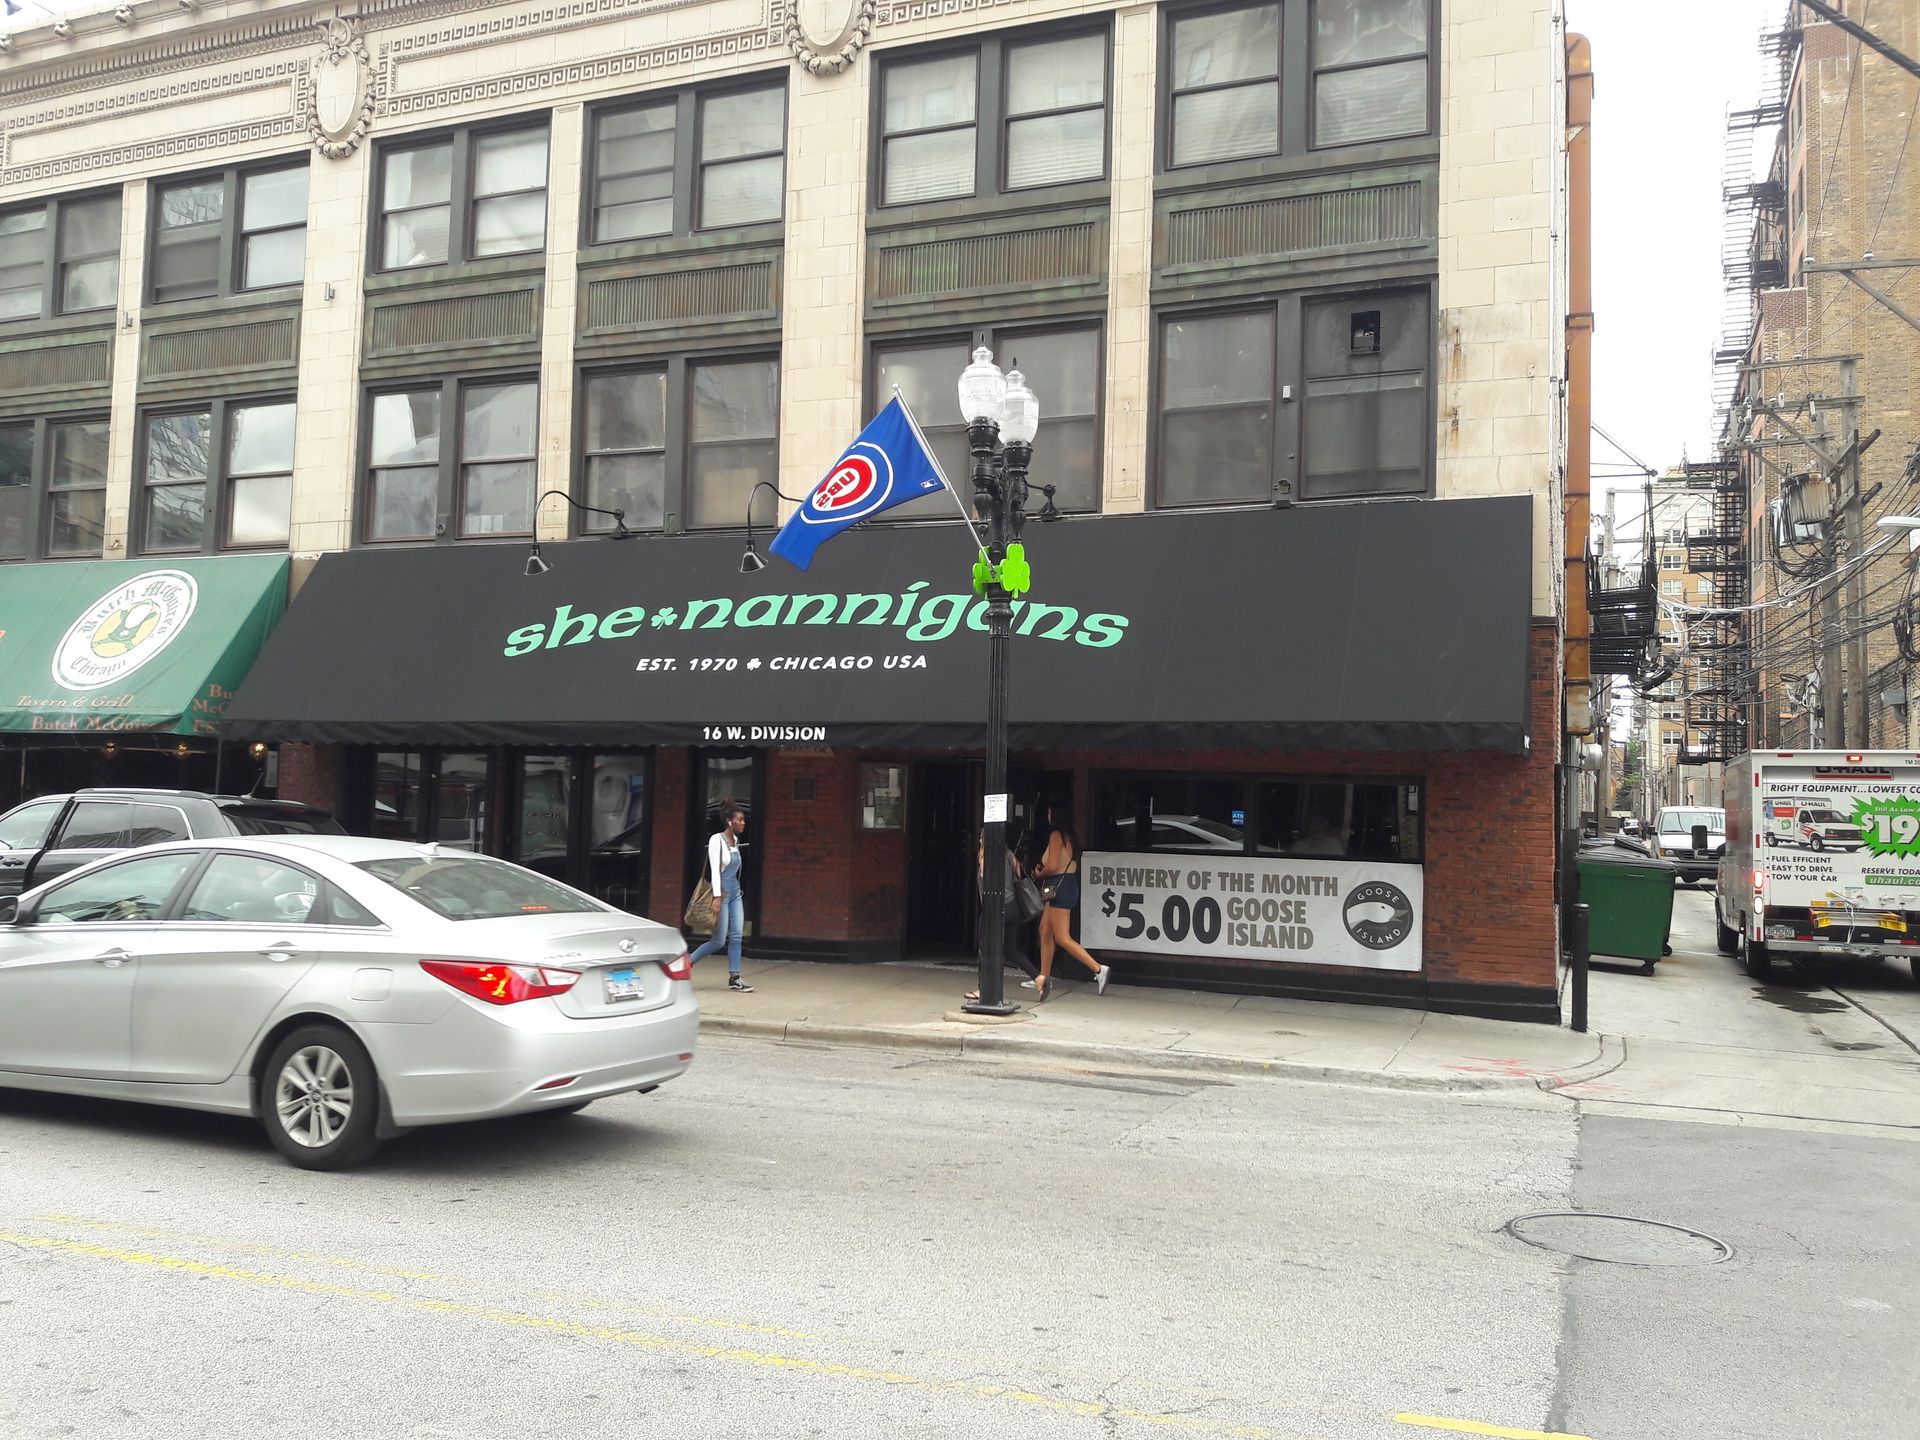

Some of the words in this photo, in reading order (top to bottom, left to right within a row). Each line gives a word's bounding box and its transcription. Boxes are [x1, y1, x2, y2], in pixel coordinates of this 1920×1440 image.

[636, 658, 677, 671] EST.
[690, 658, 738, 671] 1970
[769, 656, 874, 671] CHICAGO
[884, 655, 927, 670] USA
[17, 695, 66, 707] Tavern
[72, 696, 88, 707] &
[91, 694, 135, 708] Grill
[32, 715, 77, 730] Butch
[703, 726, 722, 740] 16
[727, 726, 746, 740] W.
[751, 726, 826, 741] DIVISION
[1770, 784, 1799, 792] RIGHT
[1771, 855, 1791, 863] FUEL
[1792, 856, 1832, 864] EFFICIENT
[1809, 865, 1833, 873] DRIVE
[1861, 867, 1895, 875] RESERVE
[1089, 866, 1181, 889] BREWERY
[1186, 870, 1212, 890] OF
[1218, 871, 1255, 893] THE
[1261, 874, 1339, 897] MONTH
[1821, 874, 1838, 882] CAR
[1357, 887, 1400, 904] GOOSE
[1101, 888, 1222, 944] $5.00
[1227, 896, 1307, 924] GOOSE
[1227, 923, 1314, 950] ISLAND
[1356, 927, 1401, 944] ISLAND
